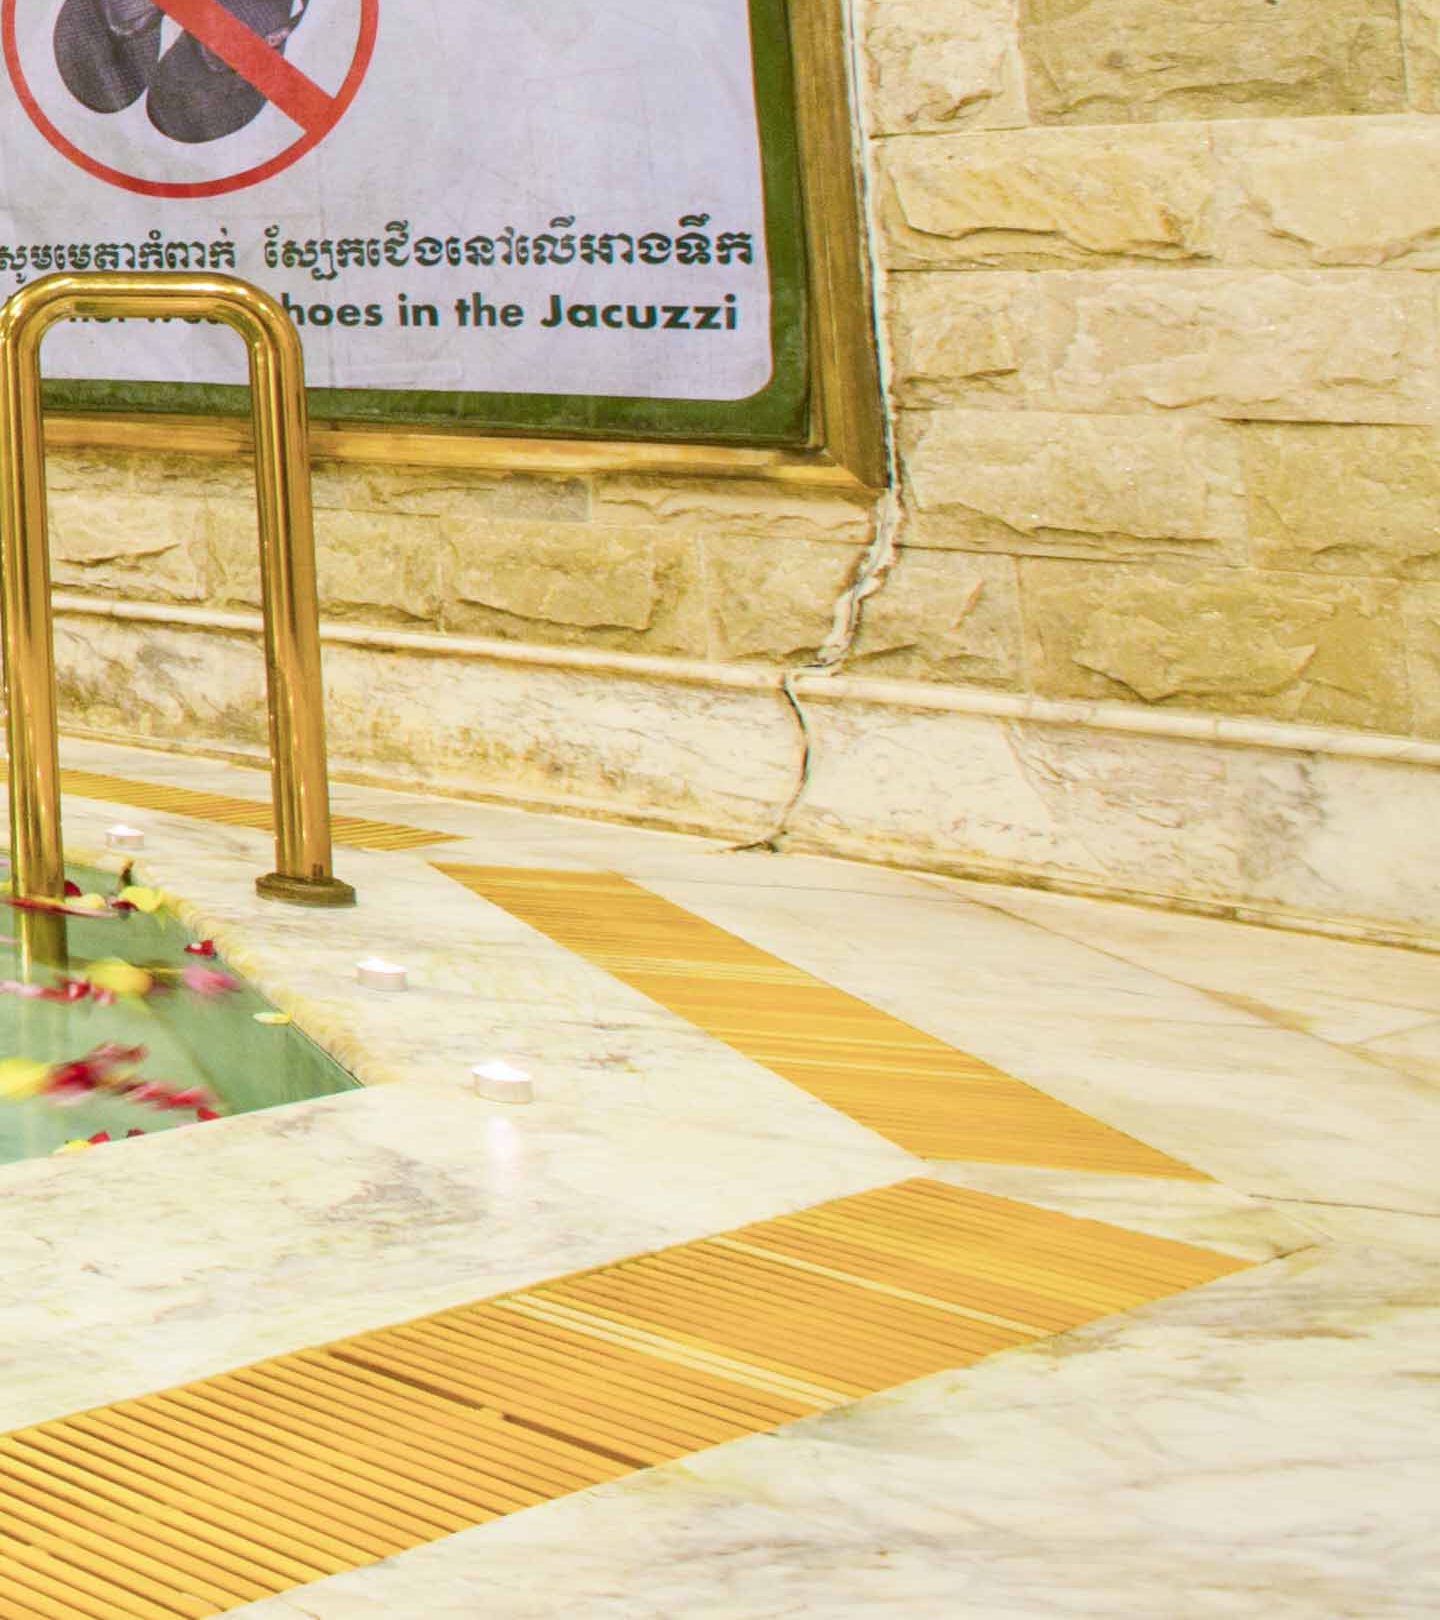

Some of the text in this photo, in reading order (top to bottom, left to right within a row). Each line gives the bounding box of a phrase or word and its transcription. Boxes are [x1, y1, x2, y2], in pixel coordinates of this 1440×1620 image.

[280, 291, 738, 331] hoes in the Jacuzzi
